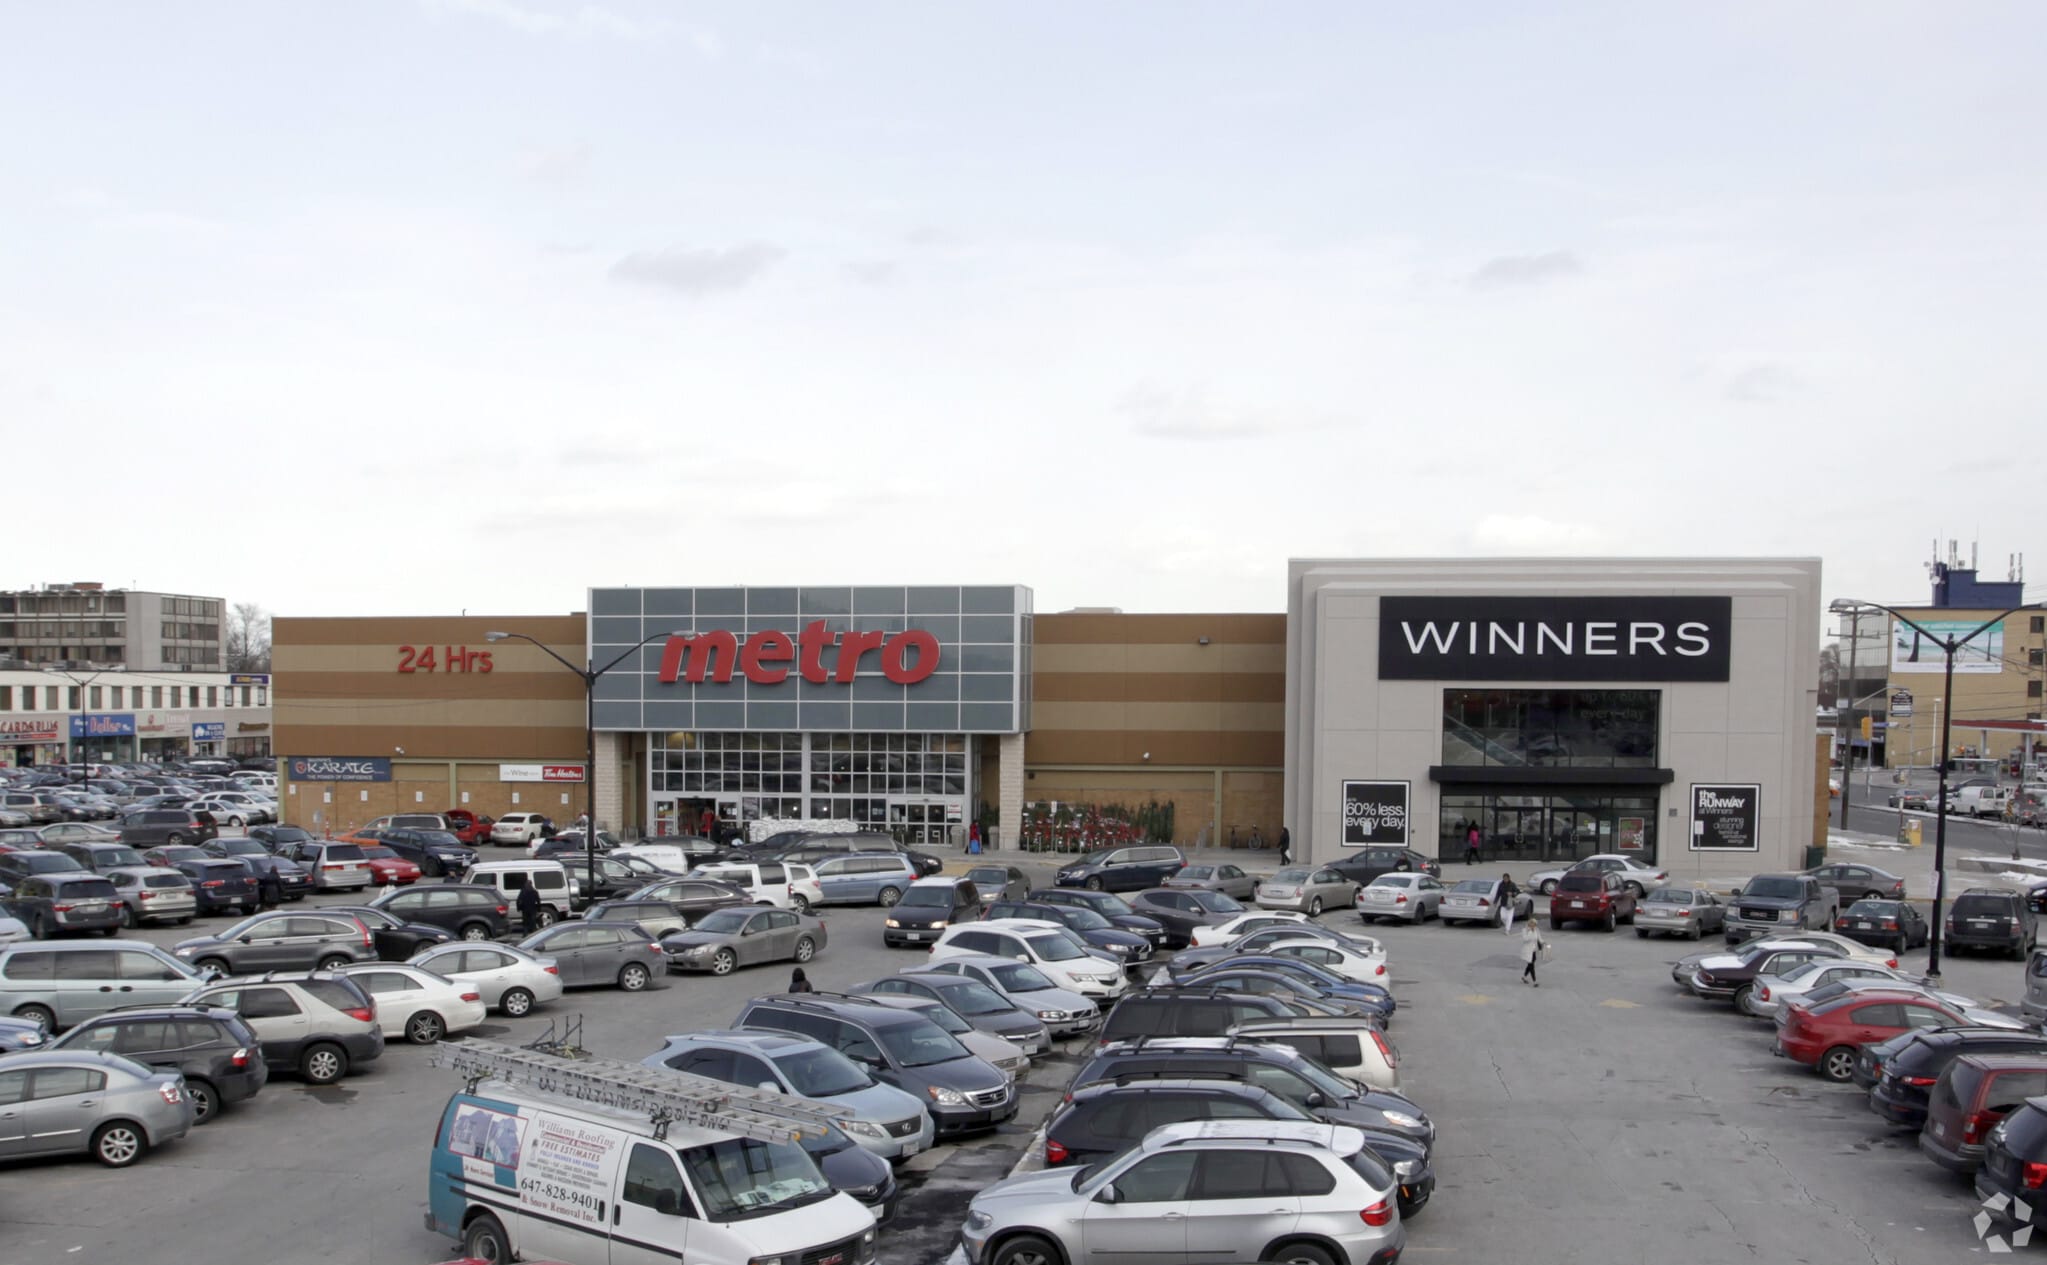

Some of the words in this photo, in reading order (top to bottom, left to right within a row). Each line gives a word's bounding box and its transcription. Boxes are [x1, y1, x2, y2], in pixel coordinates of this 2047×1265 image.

[658, 619, 941, 684] metro
[1401, 621, 1711, 656] WINNERS
[398, 646, 437, 673] 24
[446, 646, 494, 673] Hrs
[307, 762, 374, 773] KARATE
[1699, 789, 1716, 799] the
[1699, 797, 1746, 808] RUNWAY
[1346, 802, 1377, 816] 60%
[538, 1119, 576, 1137] Williams
[578, 1128, 616, 1150] Roofing
[541, 1140, 558, 1150] FREE
[560, 1145, 601, 1162] ESTIMATES
[521, 1177, 599, 1211] 647-828-9401
[529, 1196, 548, 1209] Snow
[550, 1202, 581, 1218] Removal
[582, 1211, 597, 1223] Inc.
